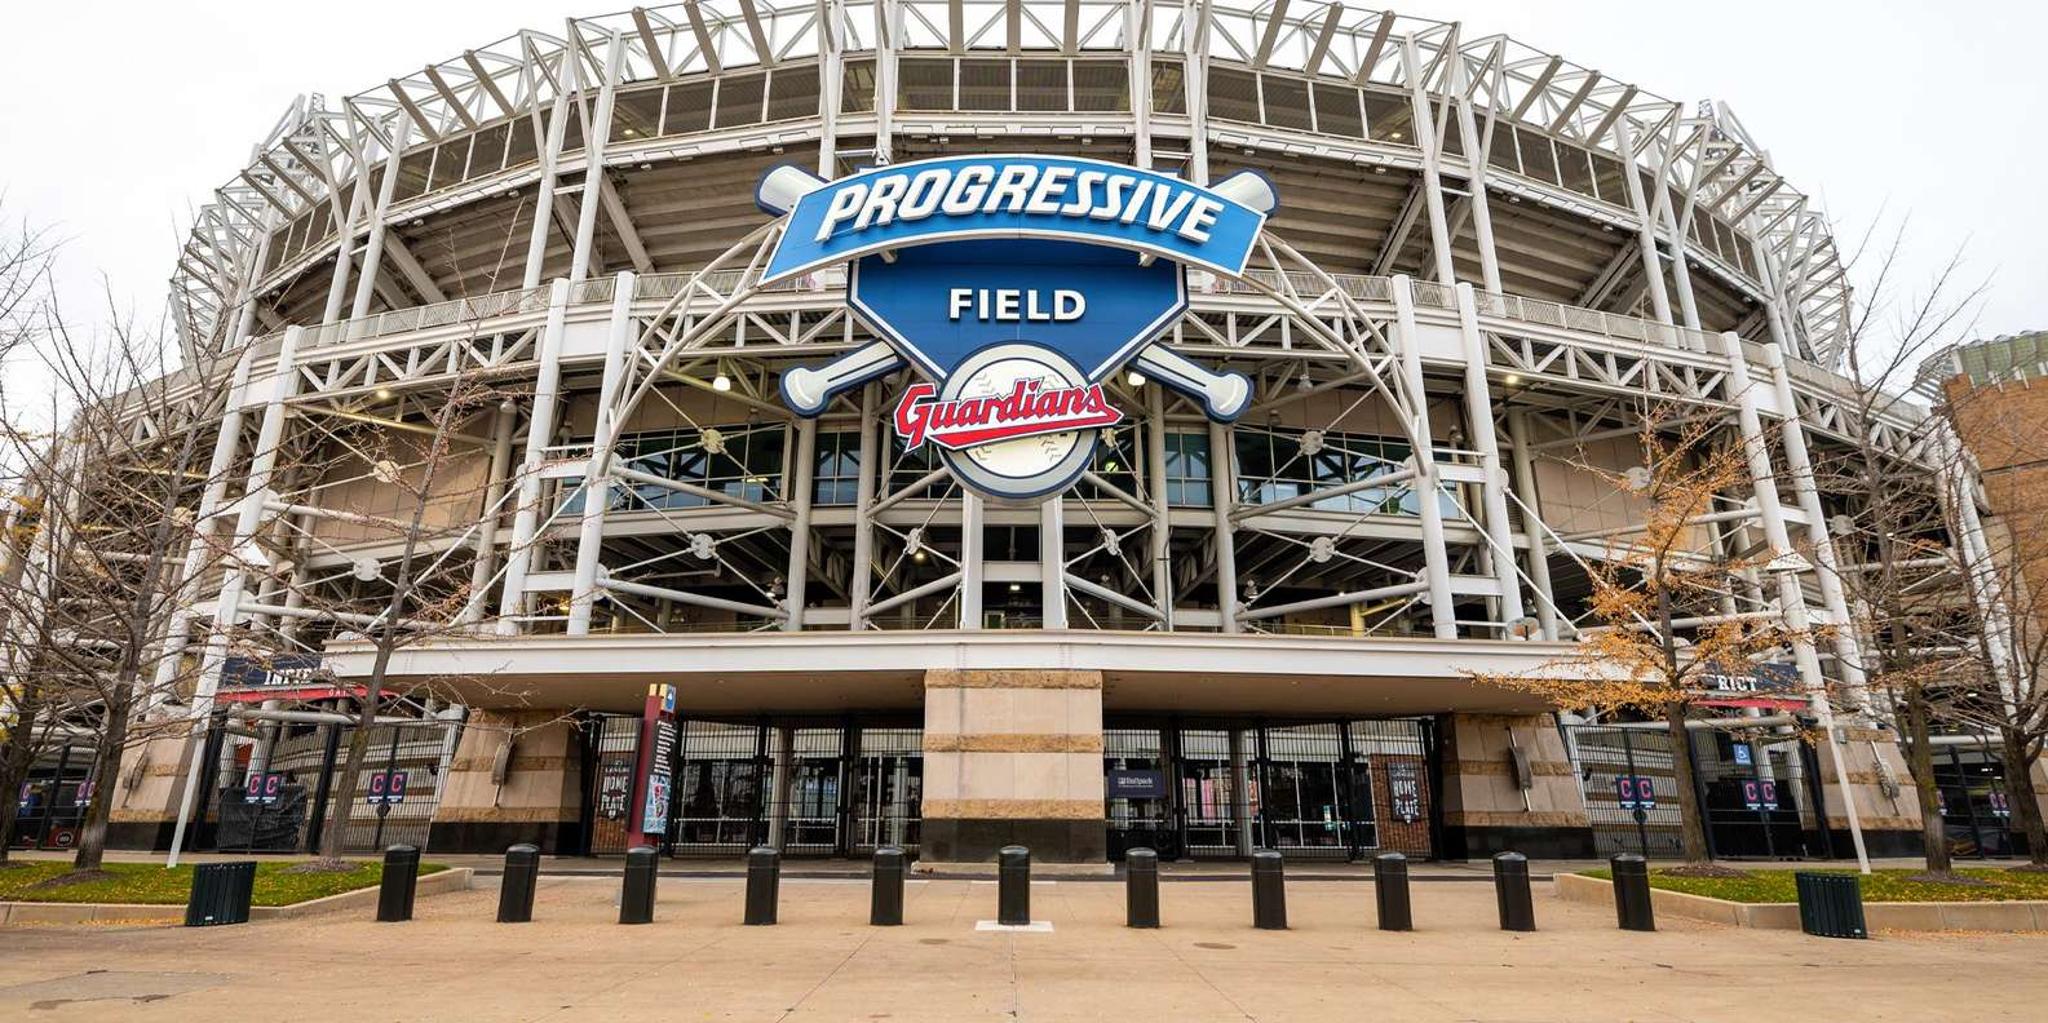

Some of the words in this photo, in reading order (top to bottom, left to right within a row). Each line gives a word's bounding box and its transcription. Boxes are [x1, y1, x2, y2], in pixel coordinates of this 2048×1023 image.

[814, 164, 1224, 243] PROGRESSIVE
[949, 288, 1086, 321] FIELD
[895, 378, 1110, 452] Guardians
[250, 775, 261, 793] C
[266, 775, 278, 793] C
[372, 775, 384, 792] C
[391, 774, 403, 792] C
